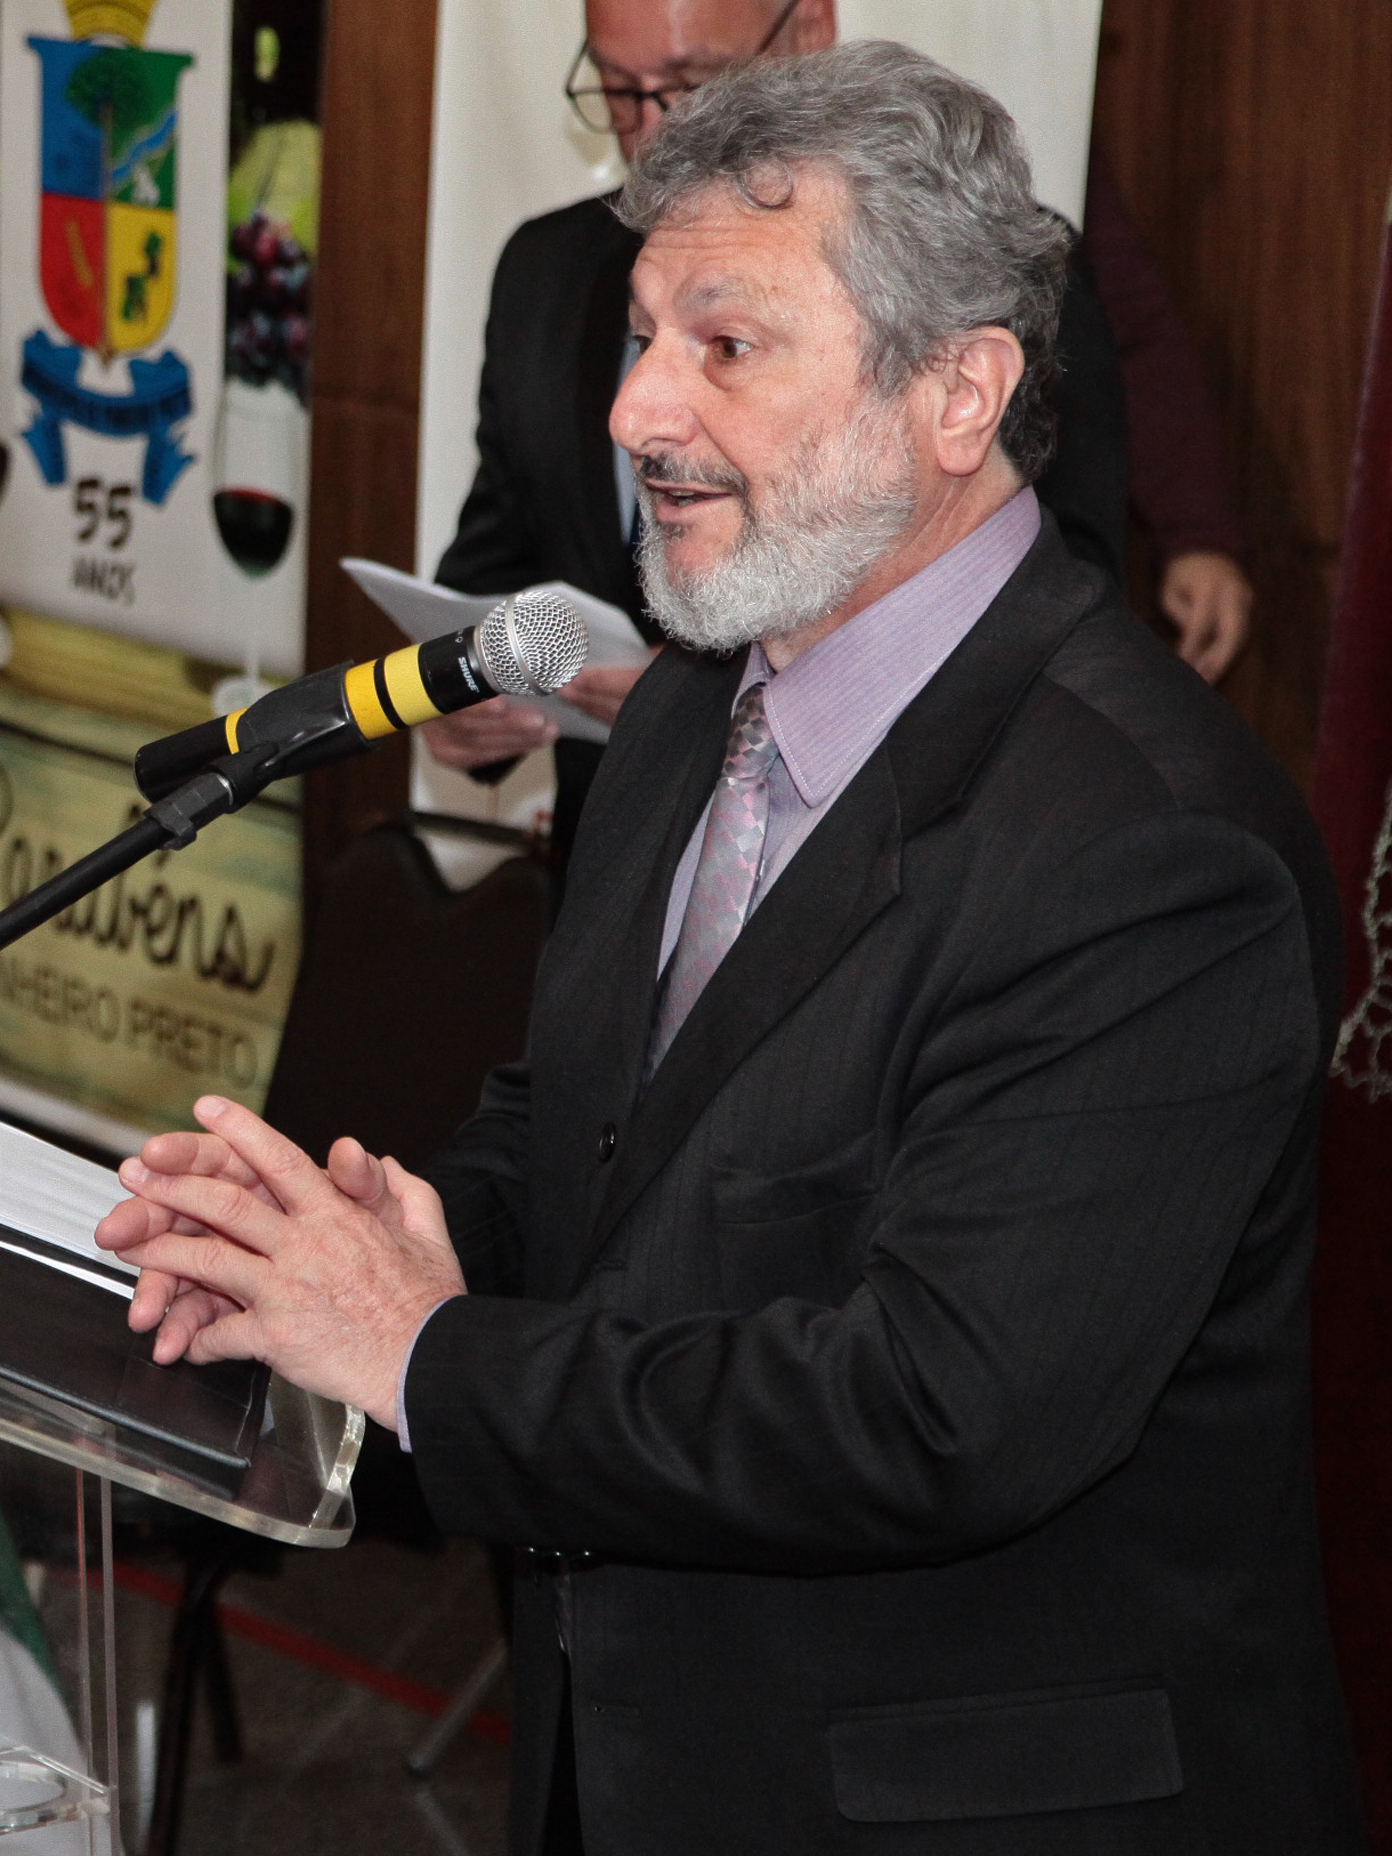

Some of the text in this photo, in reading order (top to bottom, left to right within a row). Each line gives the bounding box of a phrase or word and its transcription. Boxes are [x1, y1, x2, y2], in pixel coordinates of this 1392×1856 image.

[75, 477, 134, 551] 55
[458, 656, 480, 693] SHURE
[128, 992, 259, 1091] PRETO
